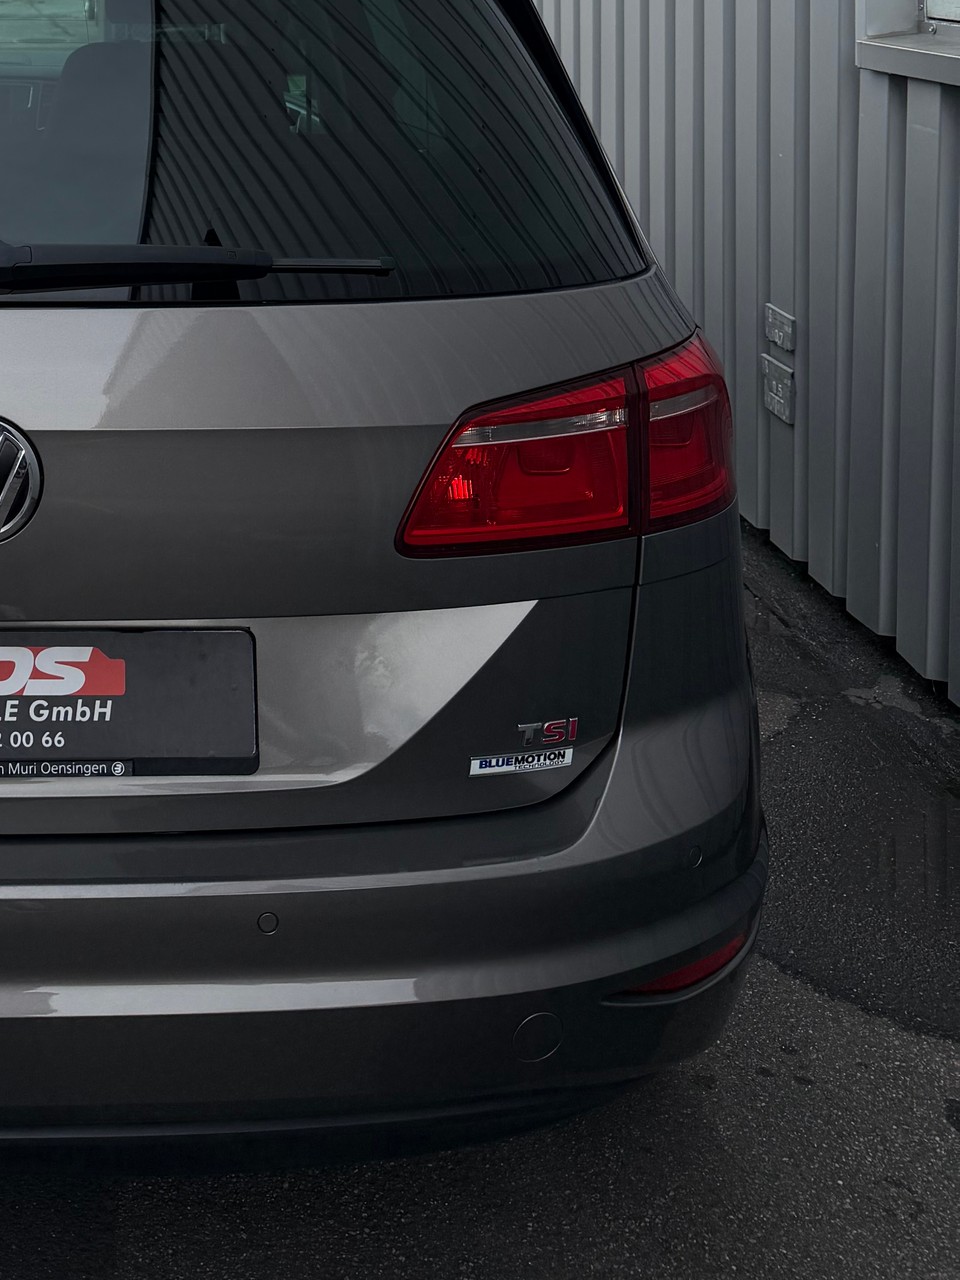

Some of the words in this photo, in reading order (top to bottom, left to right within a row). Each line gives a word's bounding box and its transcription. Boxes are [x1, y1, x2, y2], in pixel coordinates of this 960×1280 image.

[29, 699, 113, 722] GmbH
[9, 731, 34, 748] 00
[41, 731, 65, 748] 66
[517, 717, 579, 747] TSI
[8, 762, 37, 775] Muri
[40, 762, 107, 776] Oensingen
[478, 750, 566, 770] BLUEMOTION
